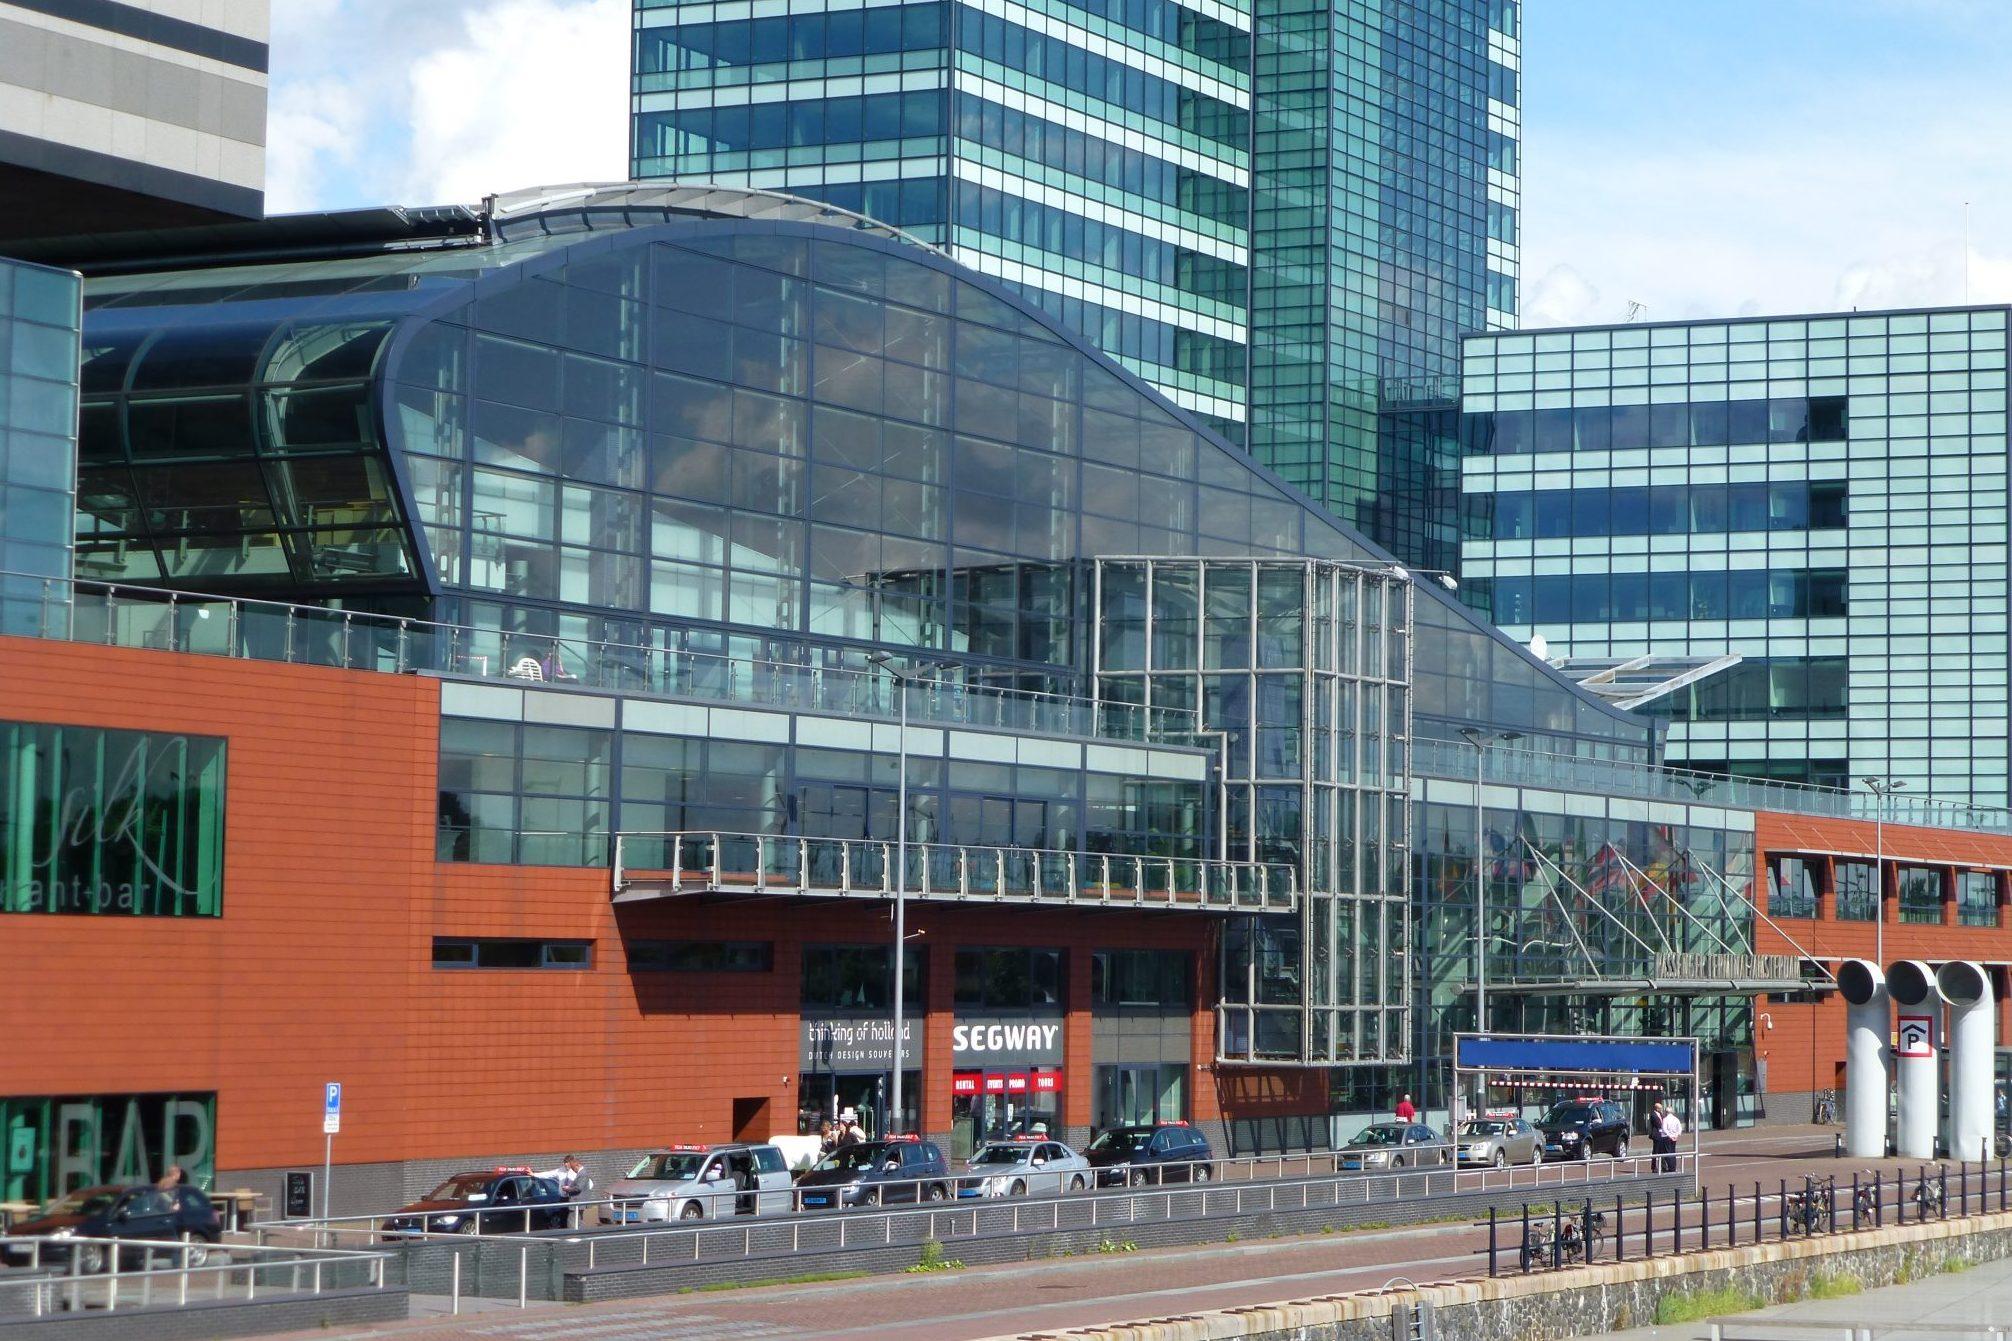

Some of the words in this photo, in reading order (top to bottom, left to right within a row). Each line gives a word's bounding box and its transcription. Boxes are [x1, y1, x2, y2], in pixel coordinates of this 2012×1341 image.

[808, 1022, 853, 1045] thinking
[856, 1022, 869, 1041] of
[952, 1024, 1058, 1051] SEGWAY
[1908, 1033, 1920, 1050] P
[837, 1050, 865, 1061] DESIGN
[868, 1049, 911, 1059] SOUVERS
[955, 1079, 975, 1090] RENTAL
[1008, 1078, 1026, 1089] PROMO
[1037, 1077, 1054, 1087] TOURS
[329, 1085, 338, 1102] P
[58, 1101, 209, 1200] BAR
